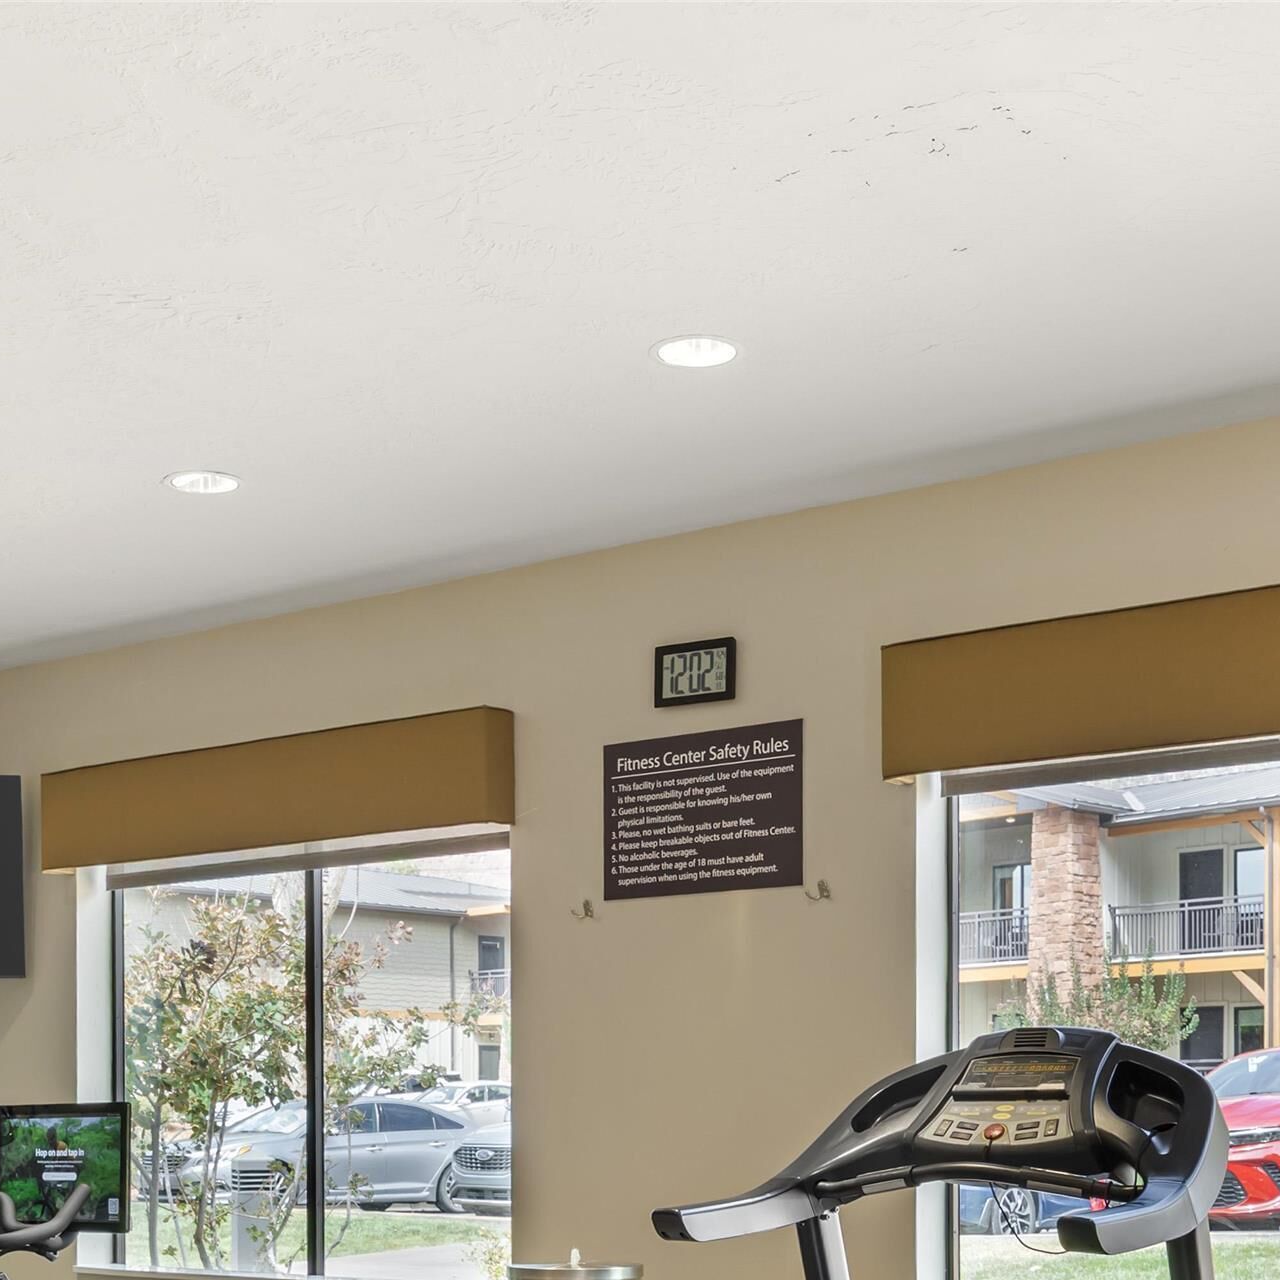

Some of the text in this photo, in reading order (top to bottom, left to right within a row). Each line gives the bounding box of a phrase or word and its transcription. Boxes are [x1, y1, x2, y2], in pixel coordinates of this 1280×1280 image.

[617, 737, 789, 773] Fitness Center Safety Rules
[611, 764, 794, 793] 1. This facility is not supervised. Use of the equipment
[617, 785, 727, 804] is the responsibility of the guest.
[618, 806, 638, 816] Guest
[646, 801, 685, 812] responsible
[686, 799, 696, 808] for
[697, 796, 728, 807] knowing
[729, 793, 755, 803] his/her
[755, 792, 772, 800] own
[611, 831, 618, 840] 3.
[653, 827, 666, 835] wet
[667, 824, 694, 834] bathing
[695, 821, 712, 831] suits
[712, 821, 721, 829] or
[721, 819, 738, 828] bare
[739, 817, 756, 826] feet.
[618, 814, 684, 829] physical limitations.
[611, 825, 796, 851] 4. Please keep breakable objects out of Fitness Center.
[611, 848, 698, 863] 5. No alcoholic beverages.
[611, 852, 764, 875] 6. Those under the age of 18 must have adult
[618, 864, 779, 887] supervision when using the fitness equipment.
[35, 1148, 47, 1158] Hop
[48, 1149, 55, 1157] on
[56, 1148, 67, 1157] and
